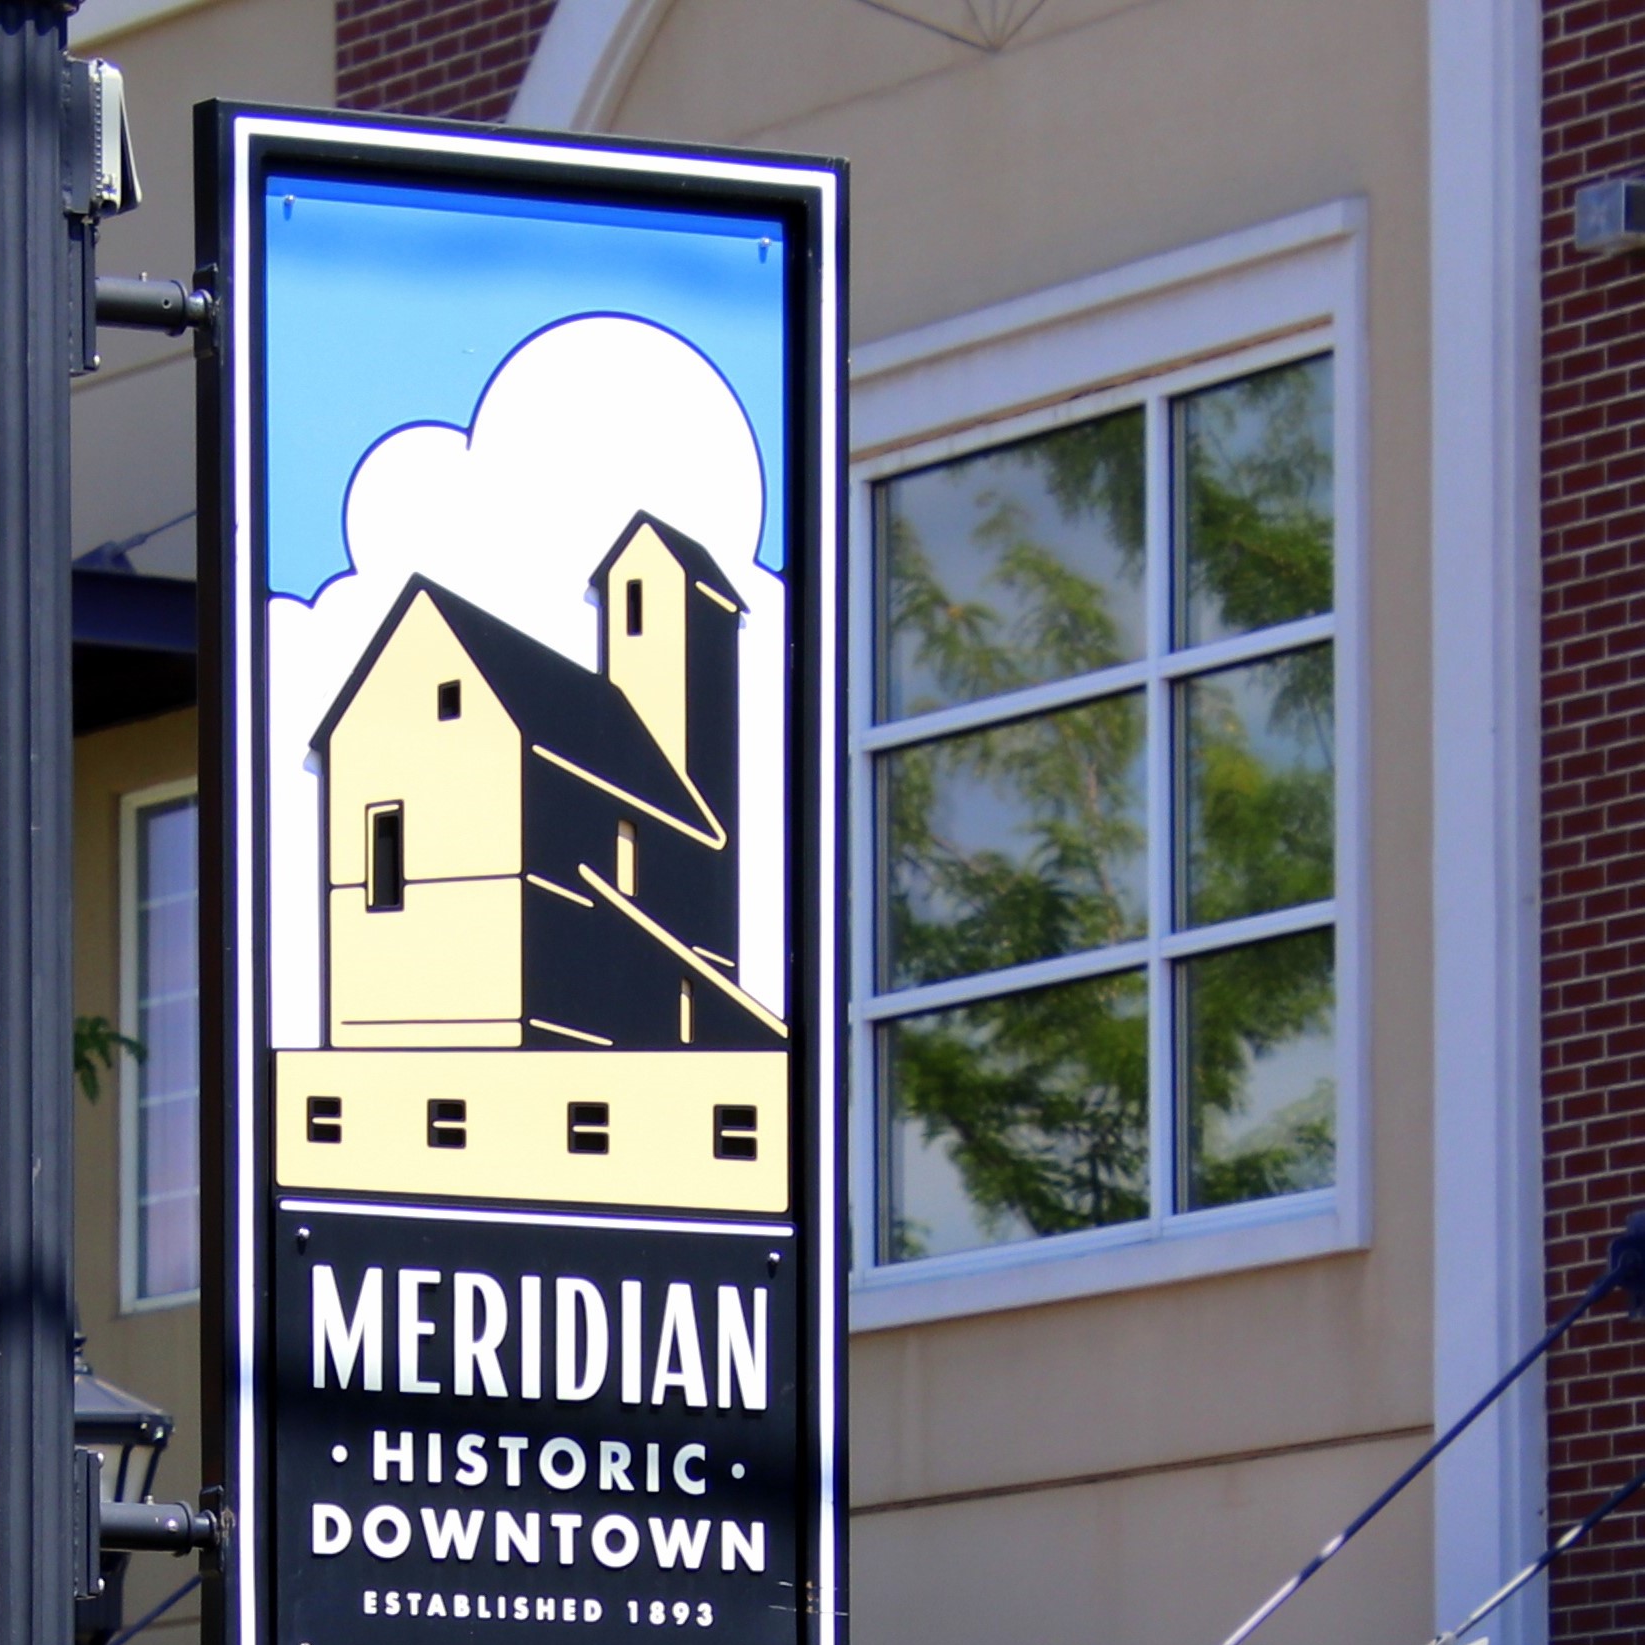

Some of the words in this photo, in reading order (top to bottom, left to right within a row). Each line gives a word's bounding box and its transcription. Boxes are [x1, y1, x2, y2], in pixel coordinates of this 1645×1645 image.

[312, 1264, 768, 1410] MERIDIAN
[373, 1430, 706, 1495] HISTORIC
[312, 1503, 766, 1572] DOWNTOWN
[363, 1590, 603, 1622] ESTABLISHED
[627, 1600, 714, 1627] 1893
